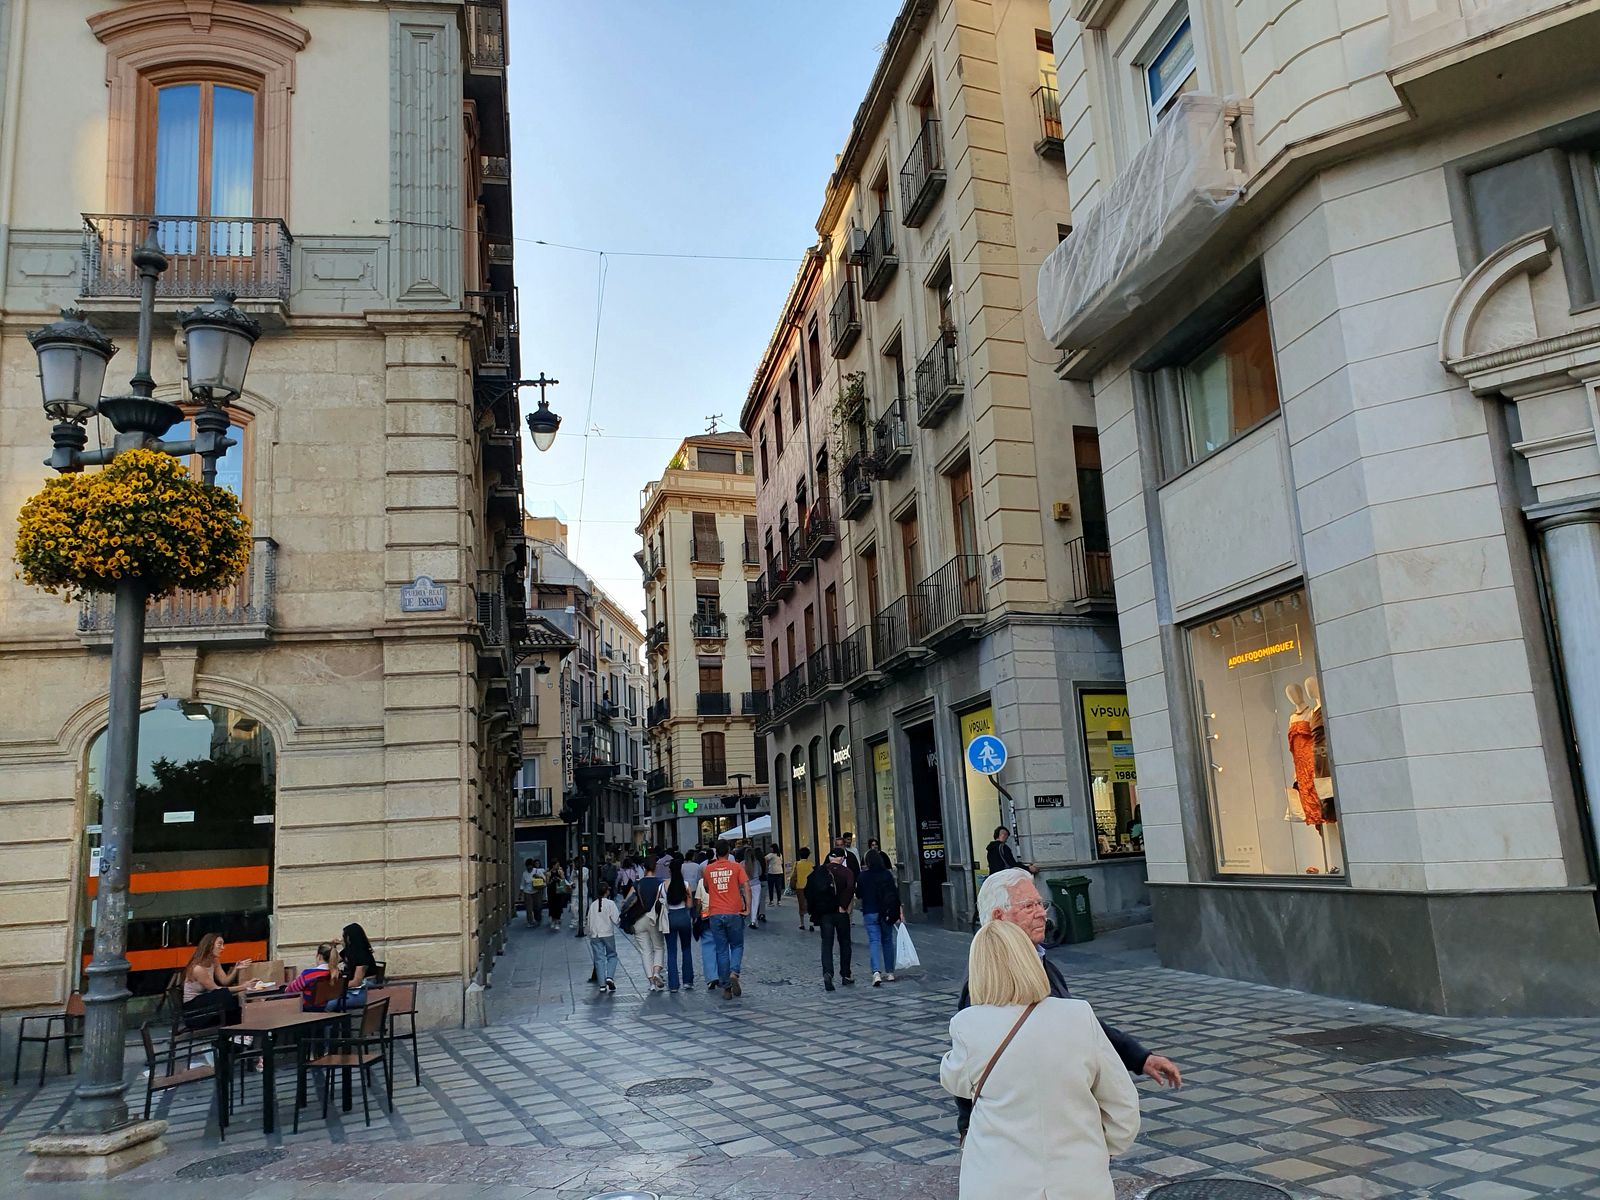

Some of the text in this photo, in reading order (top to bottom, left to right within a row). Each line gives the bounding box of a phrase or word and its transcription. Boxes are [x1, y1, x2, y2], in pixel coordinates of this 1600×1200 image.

[405, 596, 443, 607] DE ESPAÑA
[1115, 771, 1137, 780] 198€
[923, 850, 944, 859] 69€
